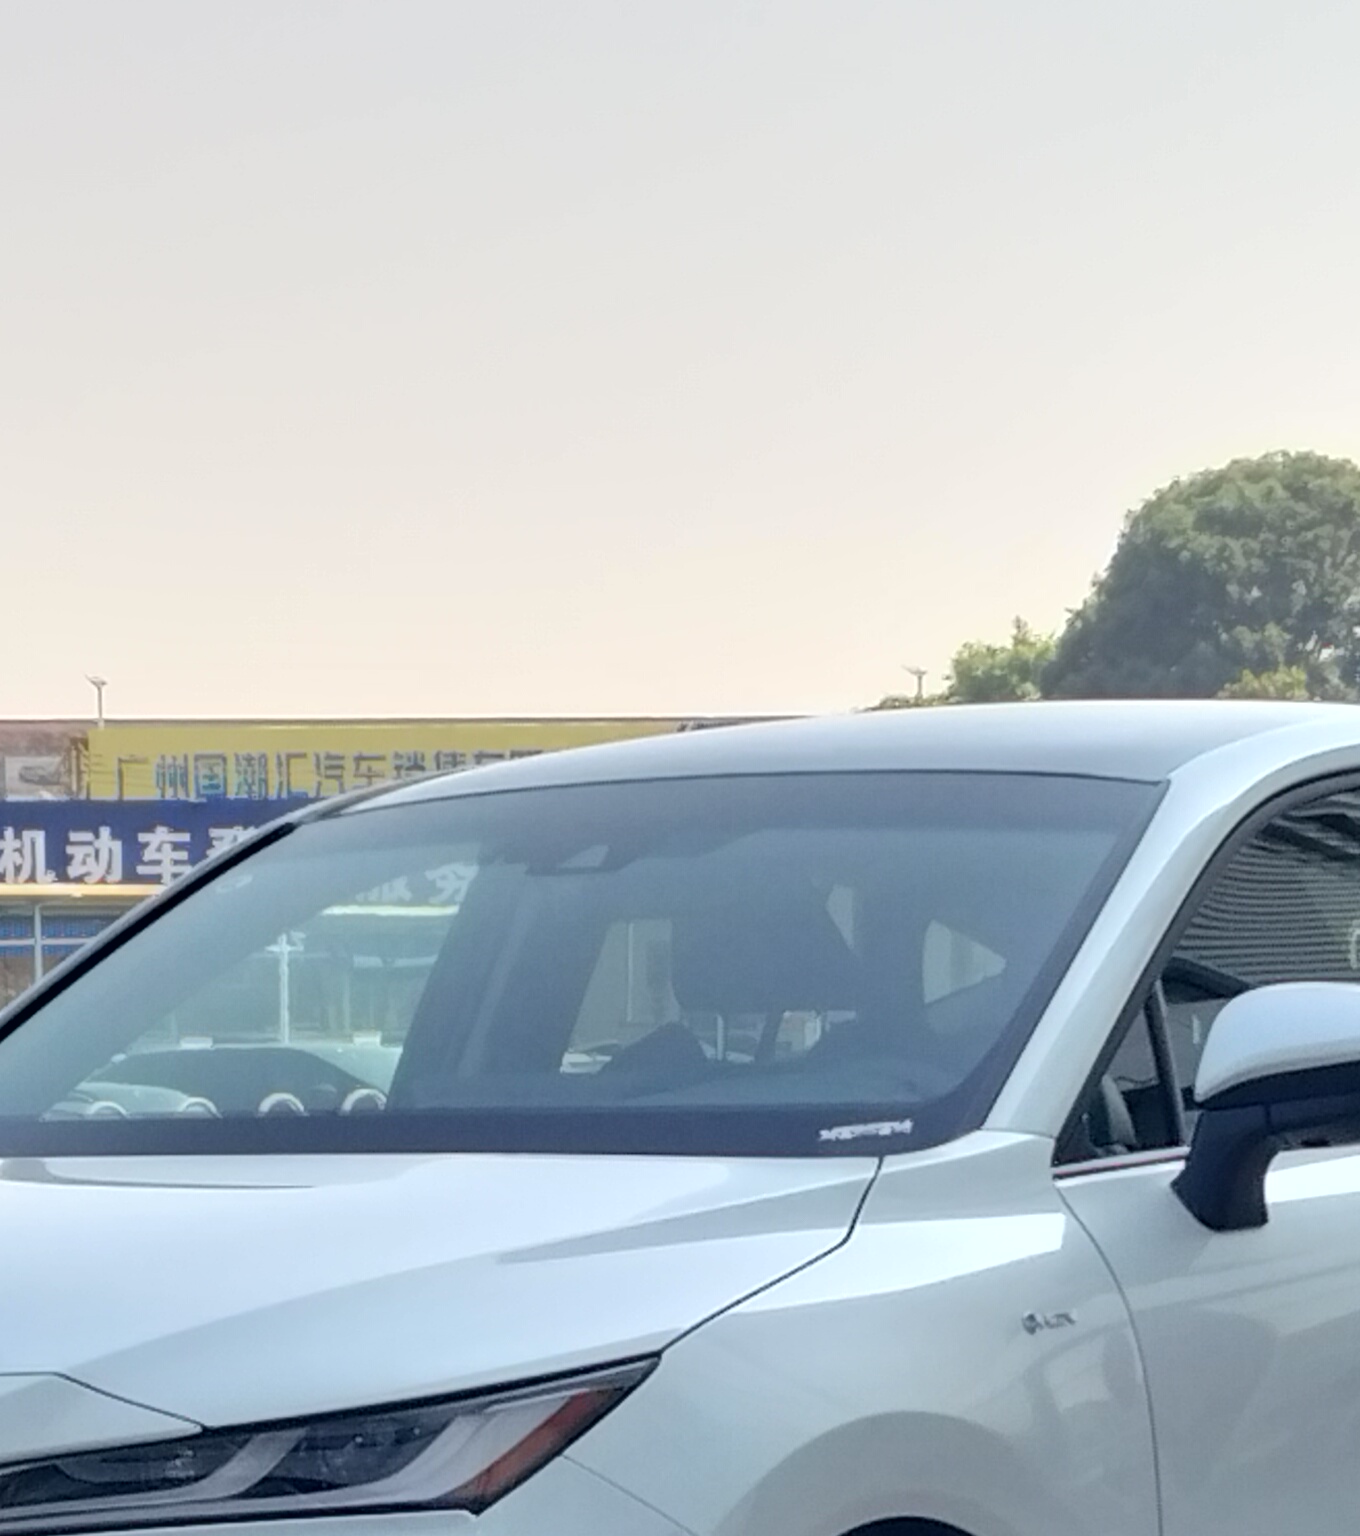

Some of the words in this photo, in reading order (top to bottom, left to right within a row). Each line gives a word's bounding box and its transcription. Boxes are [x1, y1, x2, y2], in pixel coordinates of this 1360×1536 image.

[117, 748, 542, 800] 广州国潮汇汽车销售
